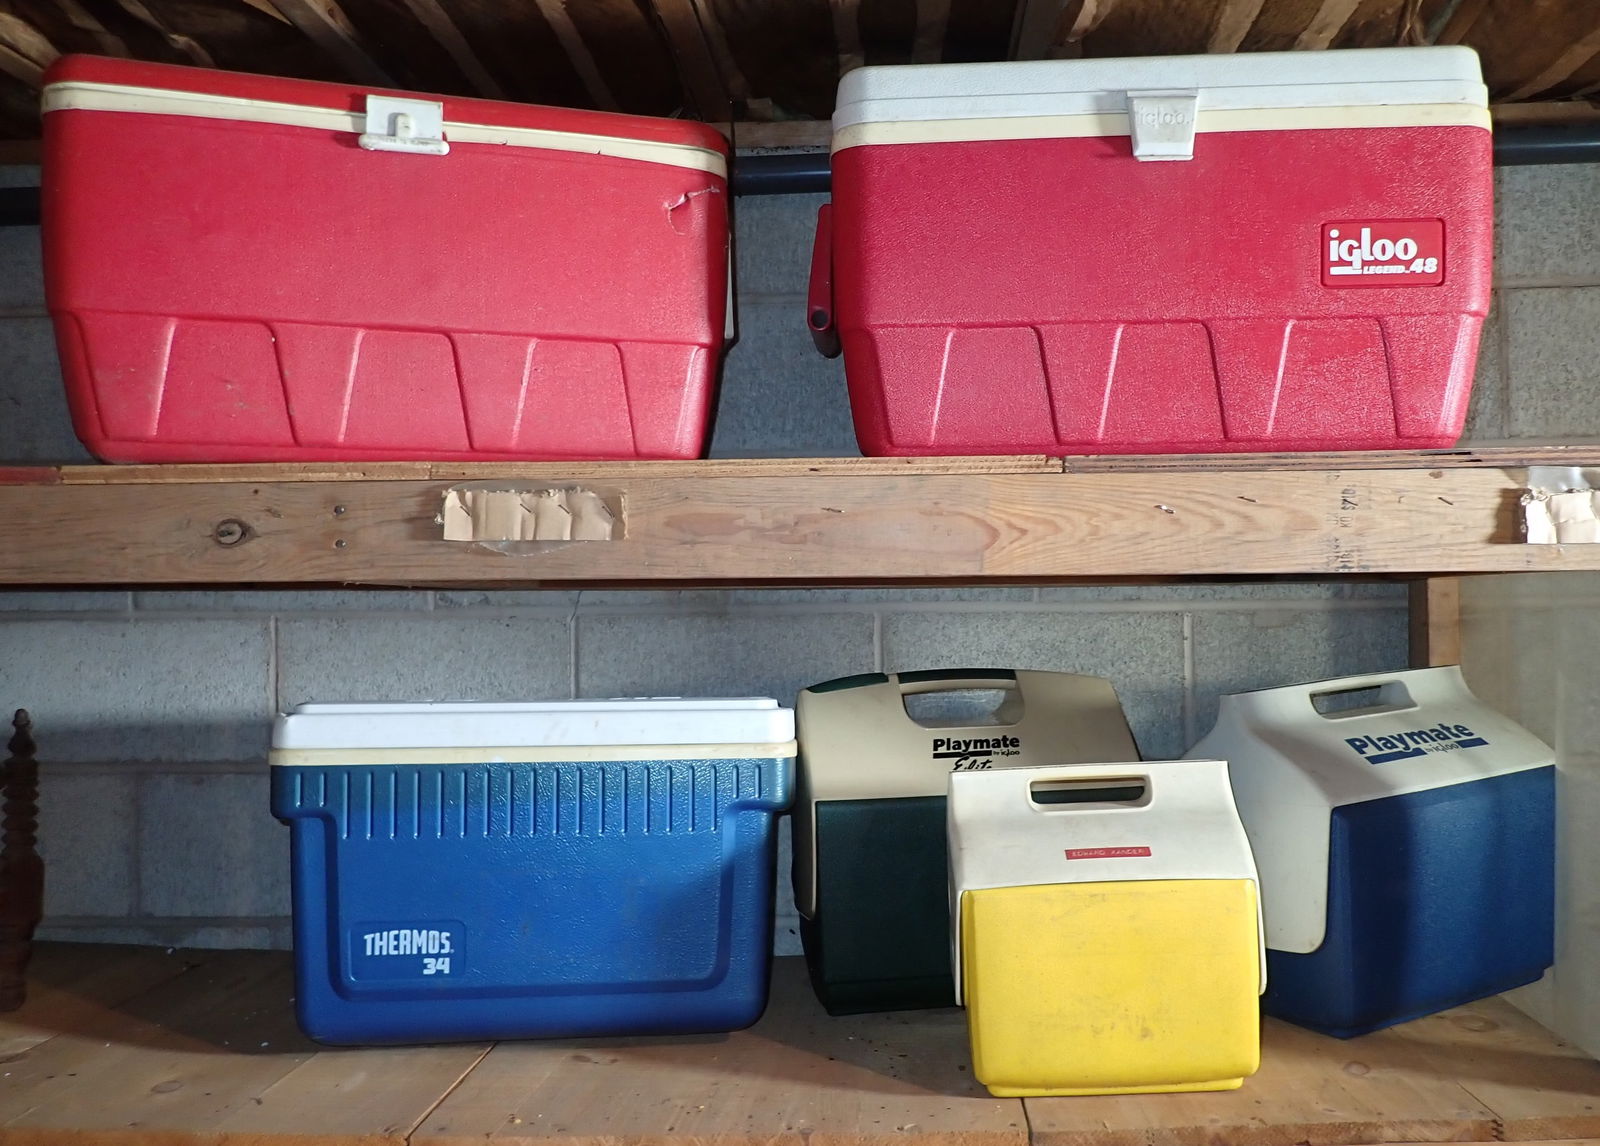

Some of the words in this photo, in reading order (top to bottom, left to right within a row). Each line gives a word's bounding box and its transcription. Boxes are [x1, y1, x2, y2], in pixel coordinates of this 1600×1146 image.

[1329, 227, 1418, 270] igloo
[1409, 257, 1438, 274] 48
[933, 735, 1020, 753] Playmate
[1344, 723, 1475, 755] Playmate
[1430, 742, 1460, 754] igloo
[1000, 749, 1020, 757] igloo
[363, 929, 451, 956] THERMOS
[423, 957, 450, 975] 34
